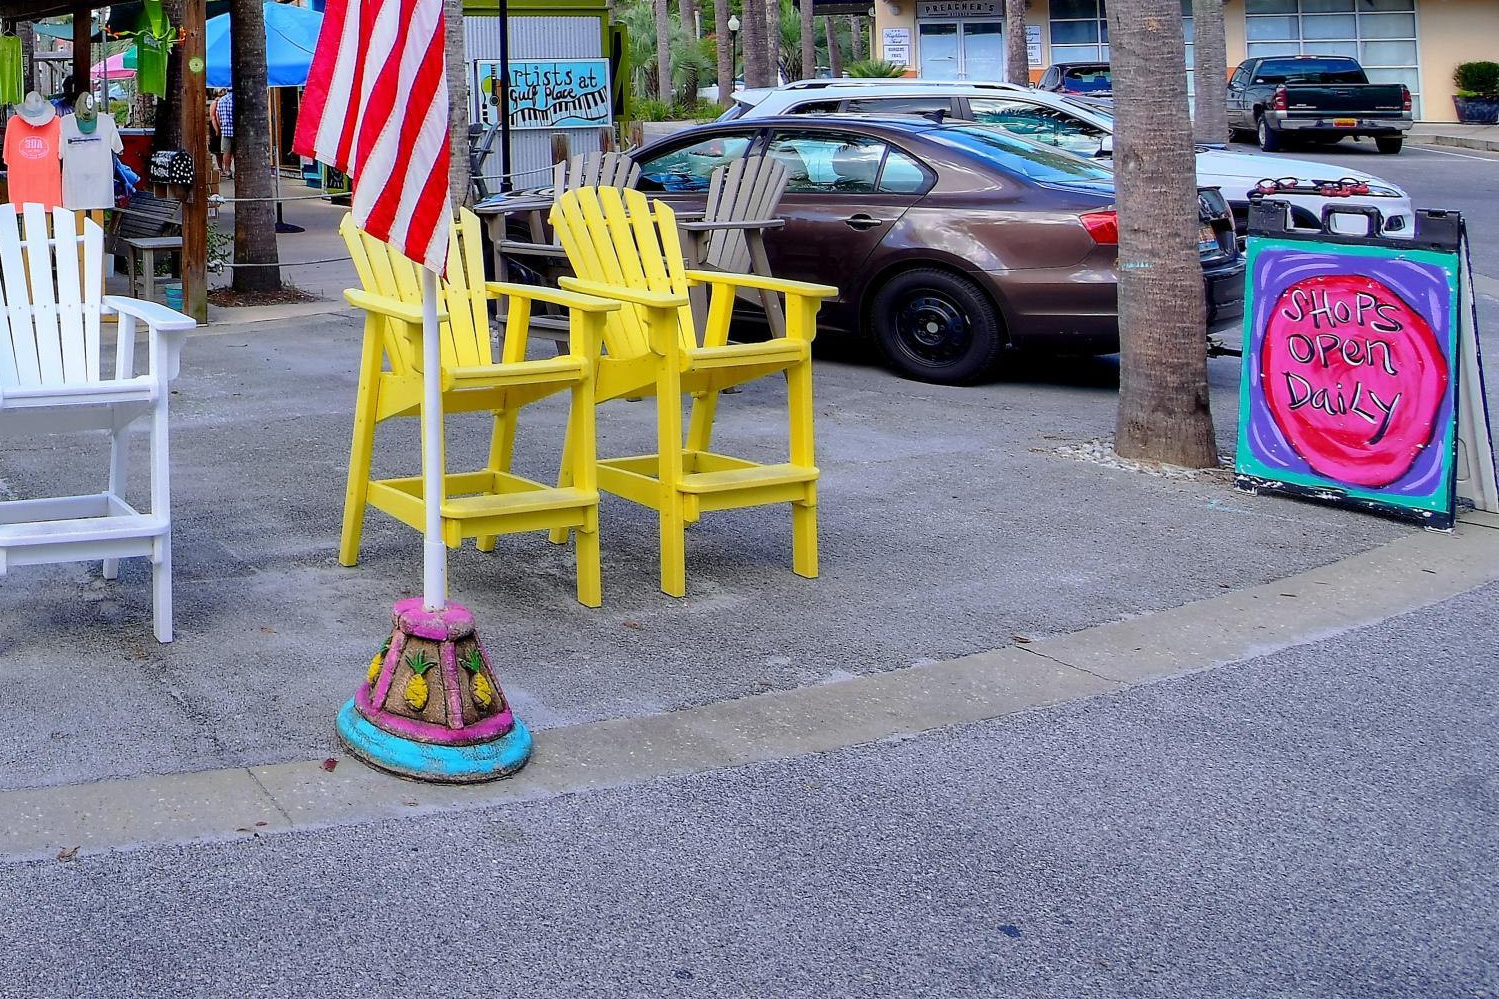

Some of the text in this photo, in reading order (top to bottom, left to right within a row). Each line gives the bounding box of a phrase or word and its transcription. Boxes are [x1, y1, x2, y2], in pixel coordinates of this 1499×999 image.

[925, 2, 995, 14] PREACHER'S
[579, 66, 598, 90] at
[509, 85, 578, 109] gulf place
